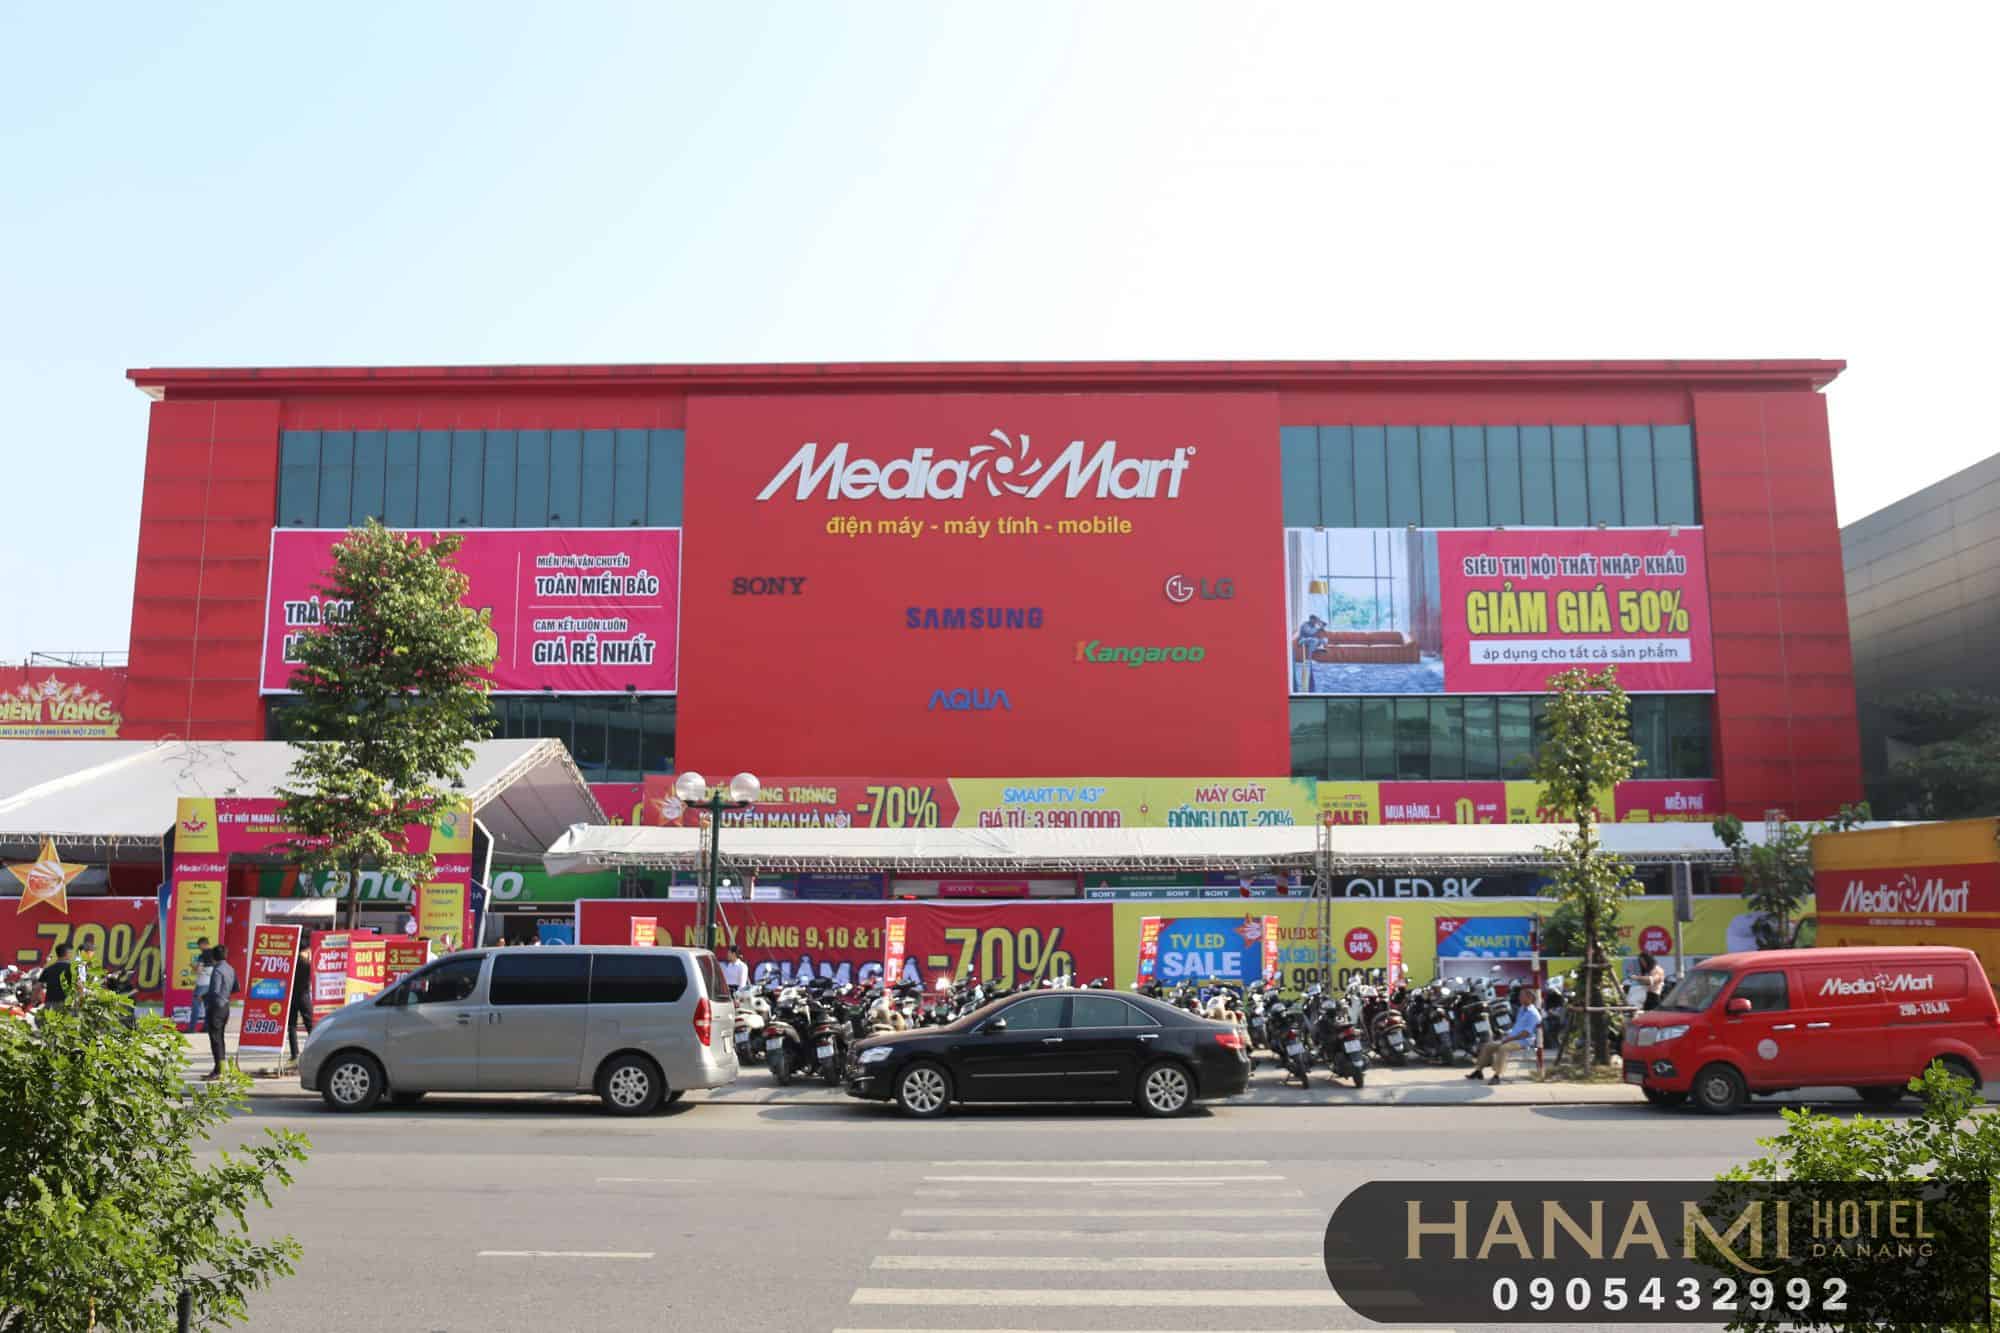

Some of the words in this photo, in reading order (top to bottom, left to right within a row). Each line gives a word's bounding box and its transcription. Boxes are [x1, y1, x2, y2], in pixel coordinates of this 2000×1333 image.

[826, 516, 872, 538] điện
[878, 516, 924, 538] máy
[944, 516, 990, 538] máy
[998, 516, 1038, 534] tính
[1058, 516, 1133, 534] mobile
[1464, 552, 1498, 577] SIÊU
[1501, 556, 1528, 580] THỊ
[1530, 552, 1558, 580] NỘI
[1560, 552, 1598, 577] THẤT
[1600, 552, 1642, 580] NHẬP
[536, 572, 579, 596] TOÀN
[625, 569, 659, 596] BẮC
[731, 577, 805, 596] SONY
[1200, 578, 1235, 600] LG
[285, 597, 320, 624] TRẢ
[906, 607, 1044, 630] SAMSUNG
[1466, 580, 1548, 635] GIẢM
[1557, 584, 1613, 634] GIÁ
[1619, 588, 1690, 634] 50%
[533, 635, 568, 665] GIÁ
[570, 633, 598, 665] RẺ
[600, 632, 656, 665] NHẤT
[1074, 640, 1205, 666] Kangaroo
[1482, 646, 1500, 661] áp
[1503, 646, 1539, 662] dụng
[1541, 646, 1567, 659] cho
[928, 688, 1012, 710] AQUA
[1003, 787, 1055, 802] SMART
[1057, 787, 1076, 802] TV
[1195, 784, 1229, 803] MÁY
[856, 785, 940, 828] -70%
[978, 807, 1003, 828] GIÁ
[1442, 878, 1483, 897] 8K
[745, 921, 800, 947] VÀNG
[1170, 934, 1192, 948] TV
[1195, 934, 1225, 948] LED
[254, 955, 290, 973] -70%
[927, 926, 1073, 990] -70%
[1163, 951, 1243, 977] SALE
[1819, 978, 1876, 996] Media
[1890, 974, 1934, 993] Mart
